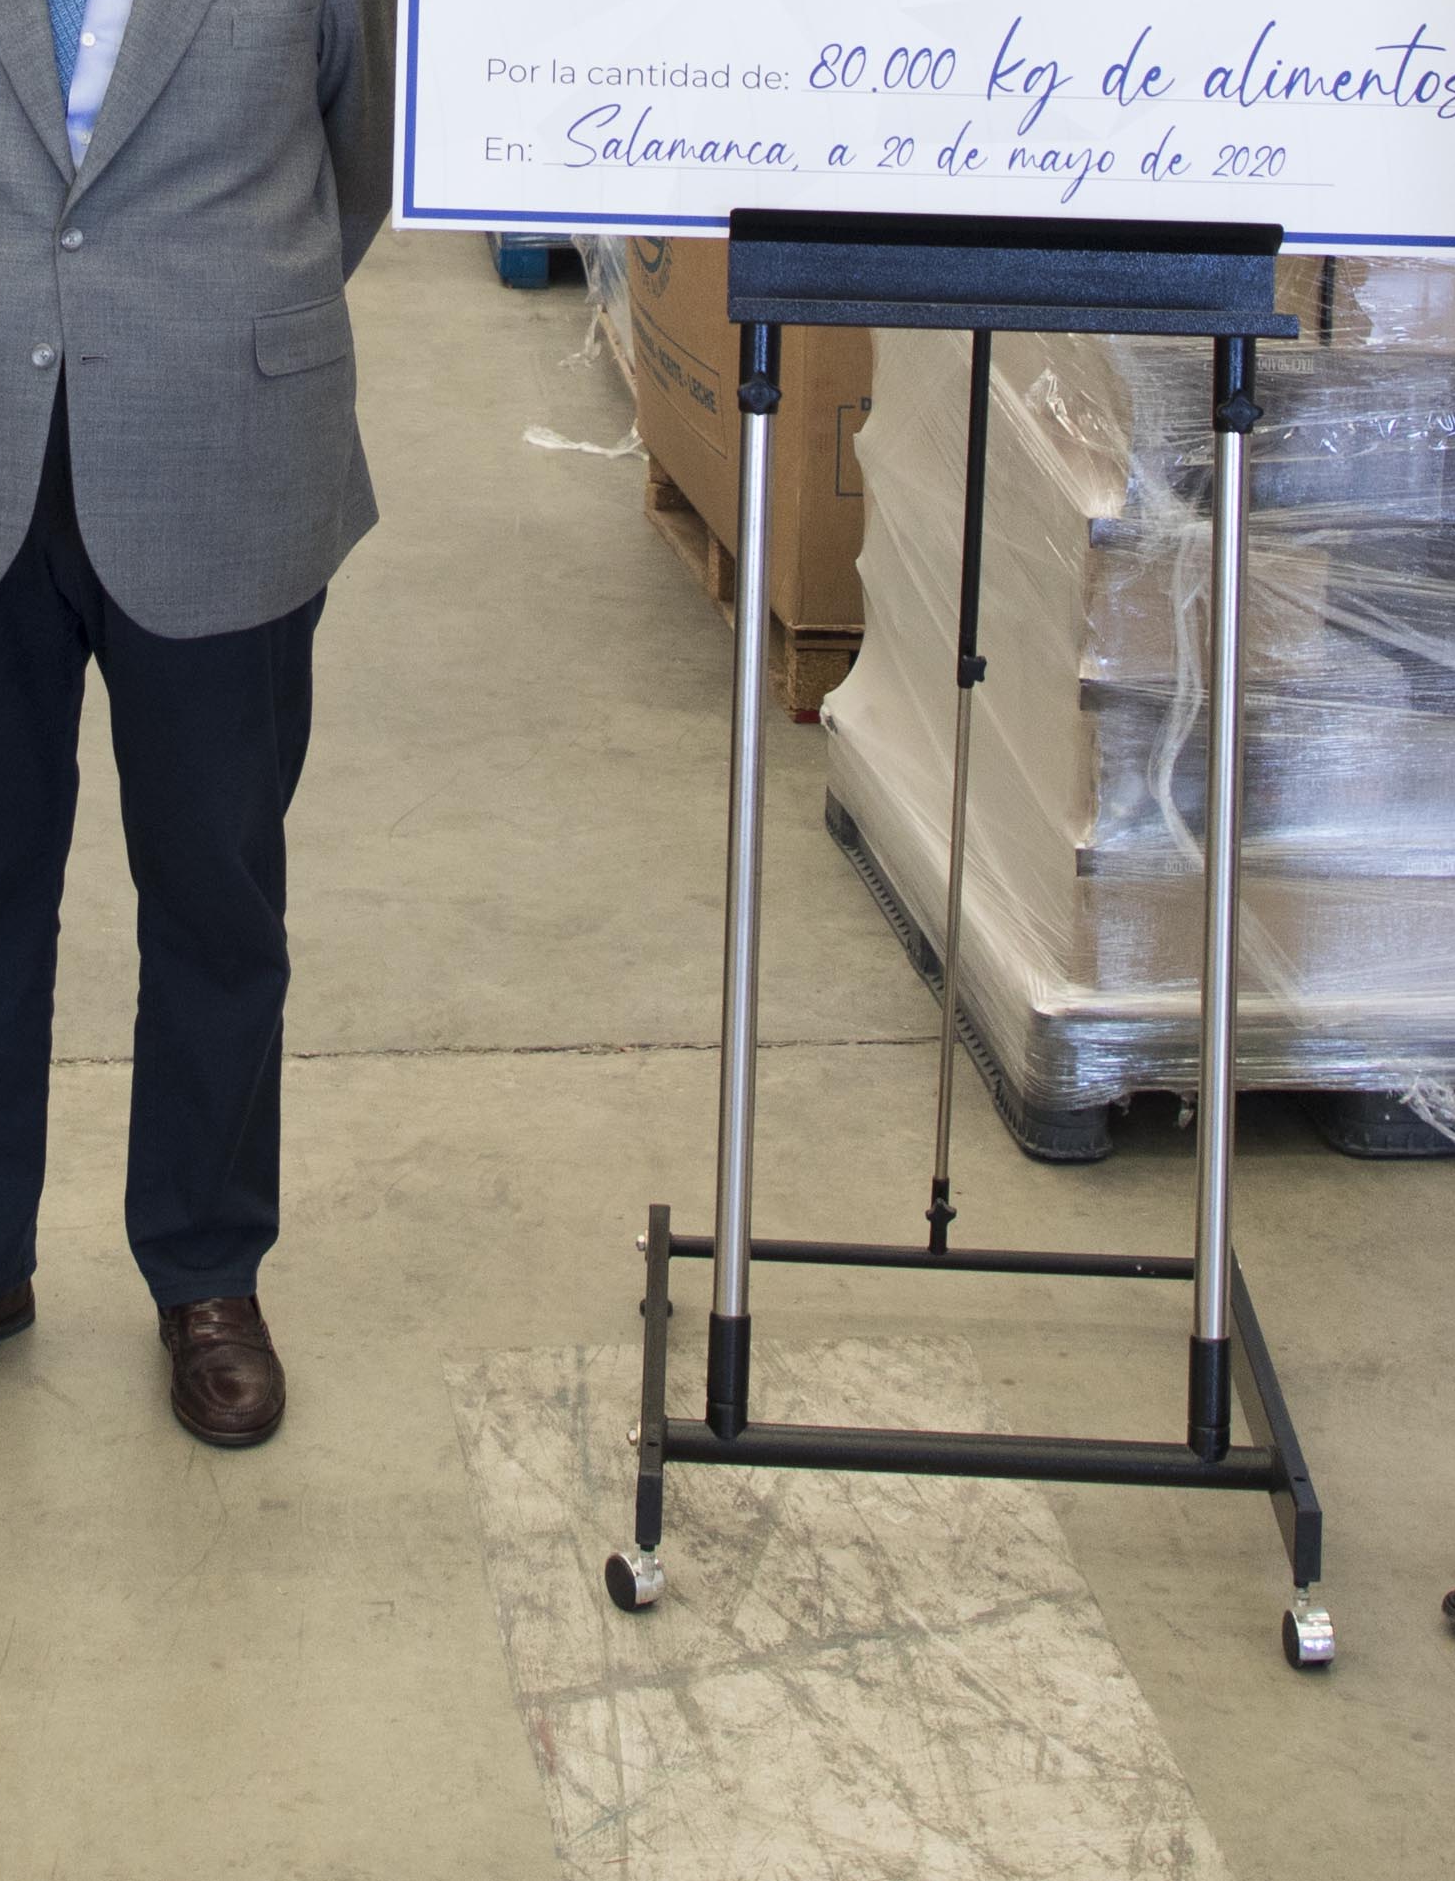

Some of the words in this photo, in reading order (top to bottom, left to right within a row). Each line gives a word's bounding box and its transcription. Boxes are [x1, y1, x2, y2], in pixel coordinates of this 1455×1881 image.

[487, 57, 545, 86] Por
[552, 57, 577, 87] la
[588, 60, 731, 89] cantidad
[742, 61, 790, 91] de:
[809, 43, 957, 94] 80.000
[988, 16, 1074, 136] kg
[1102, 25, 1174, 108] de
[485, 135, 534, 163] En:
[563, 102, 801, 172] Salamanca,
[827, 141, 857, 166] a
[876, 134, 916, 169] 20
[937, 119, 988, 177] de
[1008, 145, 1115, 204] mayo
[1141, 124, 1192, 183] de
[1211, 144, 1287, 179] 2020
